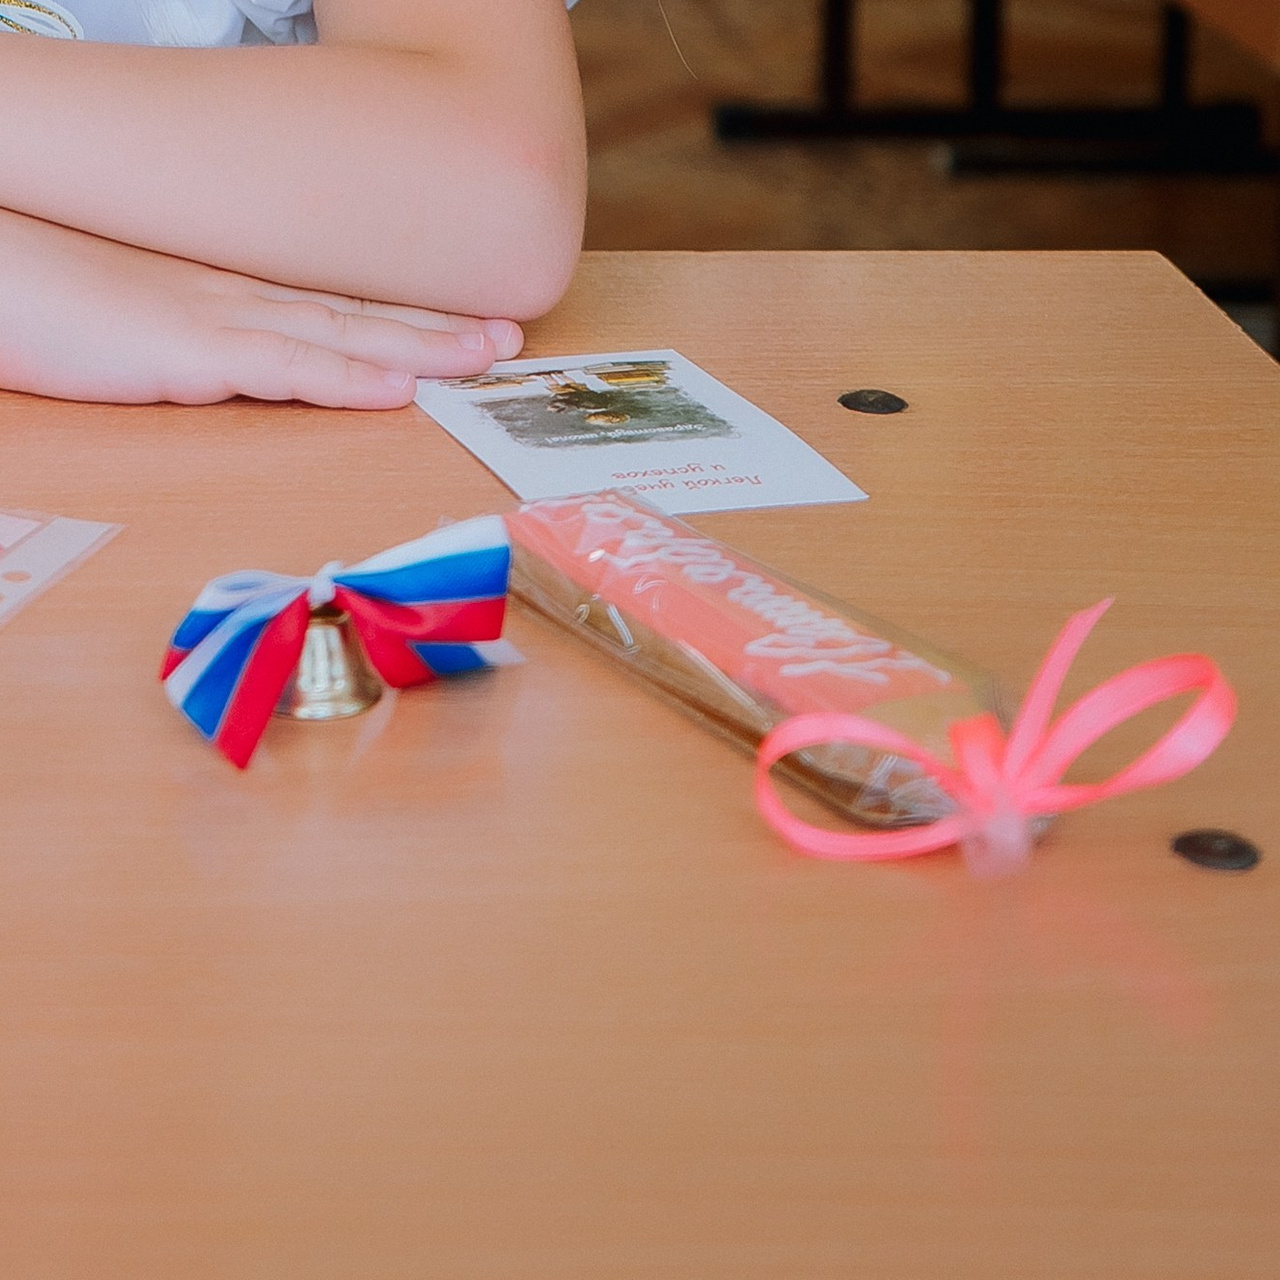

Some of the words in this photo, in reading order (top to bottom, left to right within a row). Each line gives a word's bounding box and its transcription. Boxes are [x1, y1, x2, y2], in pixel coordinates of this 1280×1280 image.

[612, 461, 705, 481] успехов
[710, 462, 727, 472] и
[684, 474, 763, 492] Легкой
